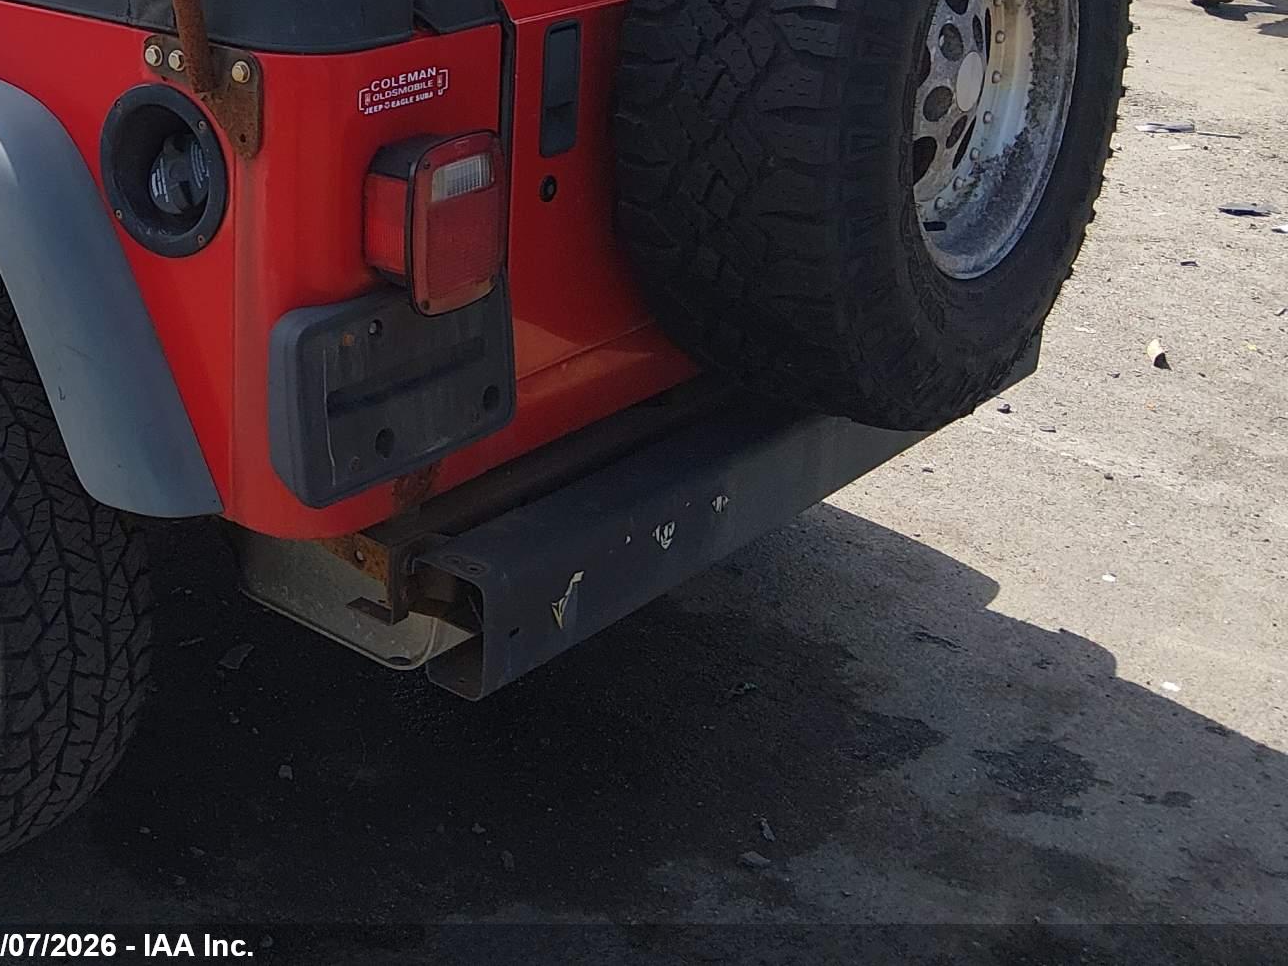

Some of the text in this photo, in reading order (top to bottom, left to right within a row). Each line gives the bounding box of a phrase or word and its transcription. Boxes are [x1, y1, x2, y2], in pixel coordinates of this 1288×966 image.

[371, 67, 436, 92] COLEMAN
[372, 80, 433, 101] OLDSMOBILE
[364, 104, 383, 115] JEEP
[391, 96, 414, 108] EAGLE
